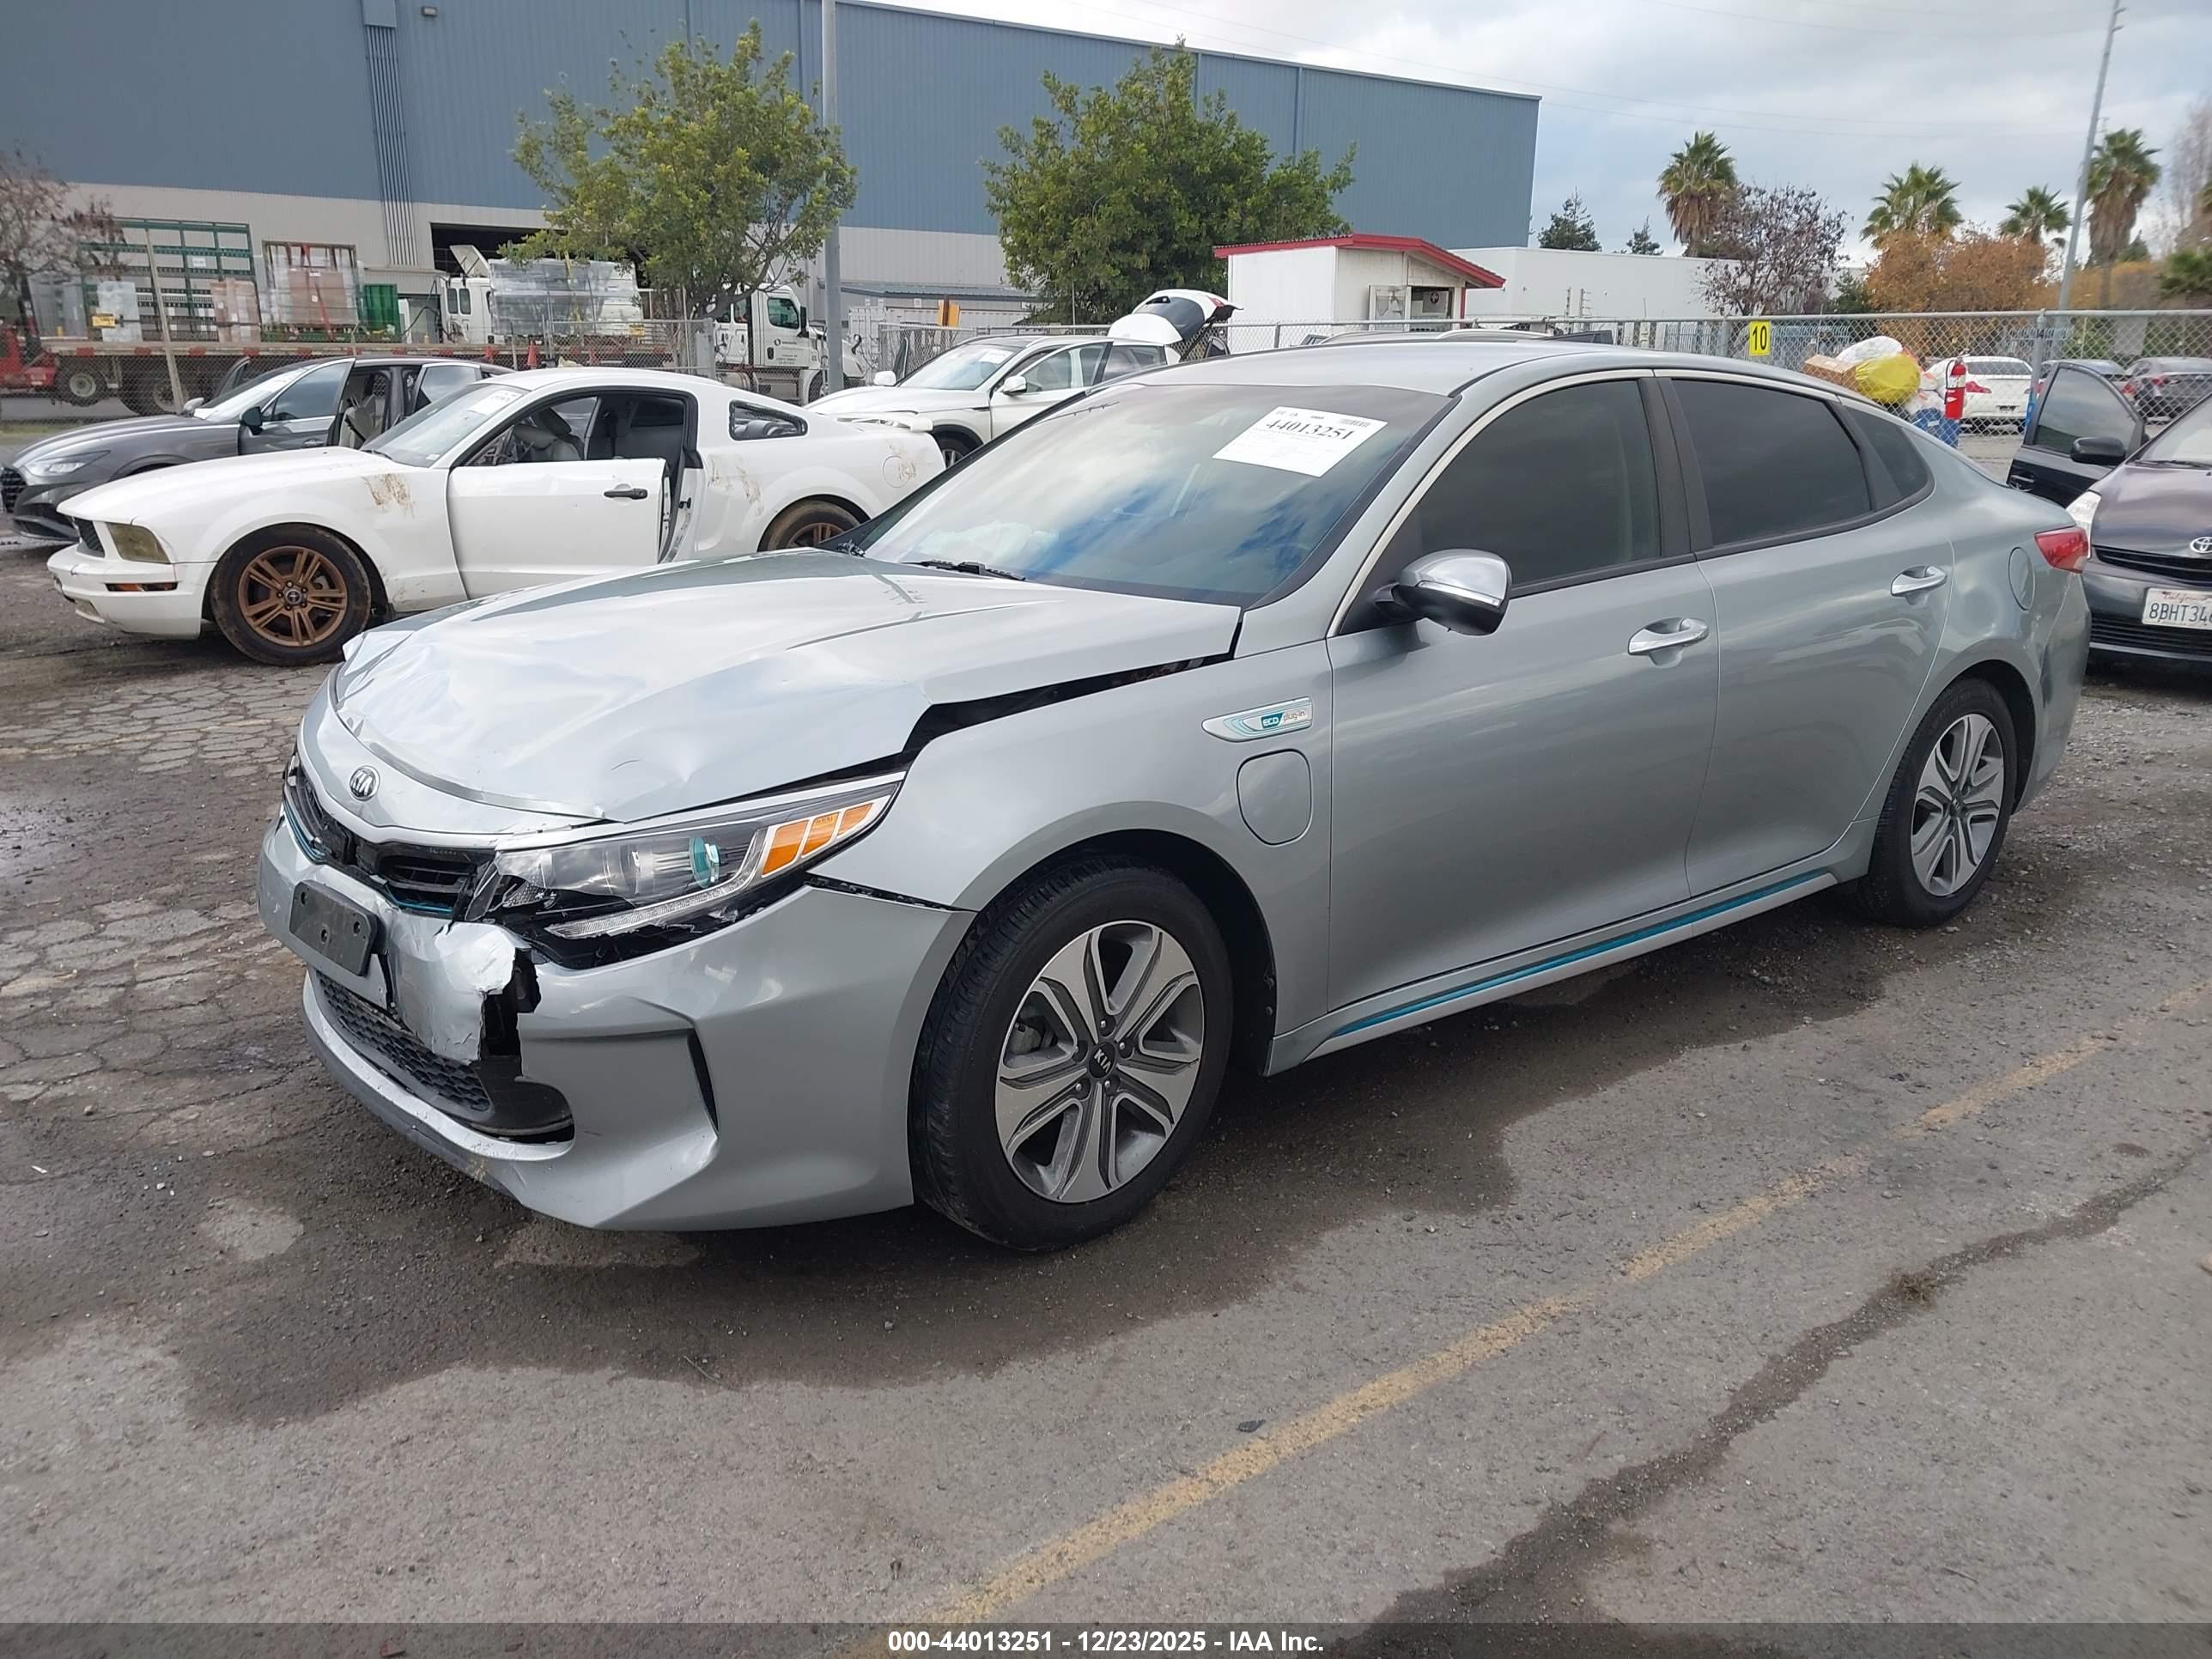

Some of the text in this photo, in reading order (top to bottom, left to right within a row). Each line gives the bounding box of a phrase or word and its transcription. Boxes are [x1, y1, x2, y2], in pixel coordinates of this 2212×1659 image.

[1753, 325, 1767, 351] 10
[1266, 419, 1355, 440] 44013251
[1263, 717, 1279, 726] ECO
[1093, 1048, 1112, 1073] KIA
